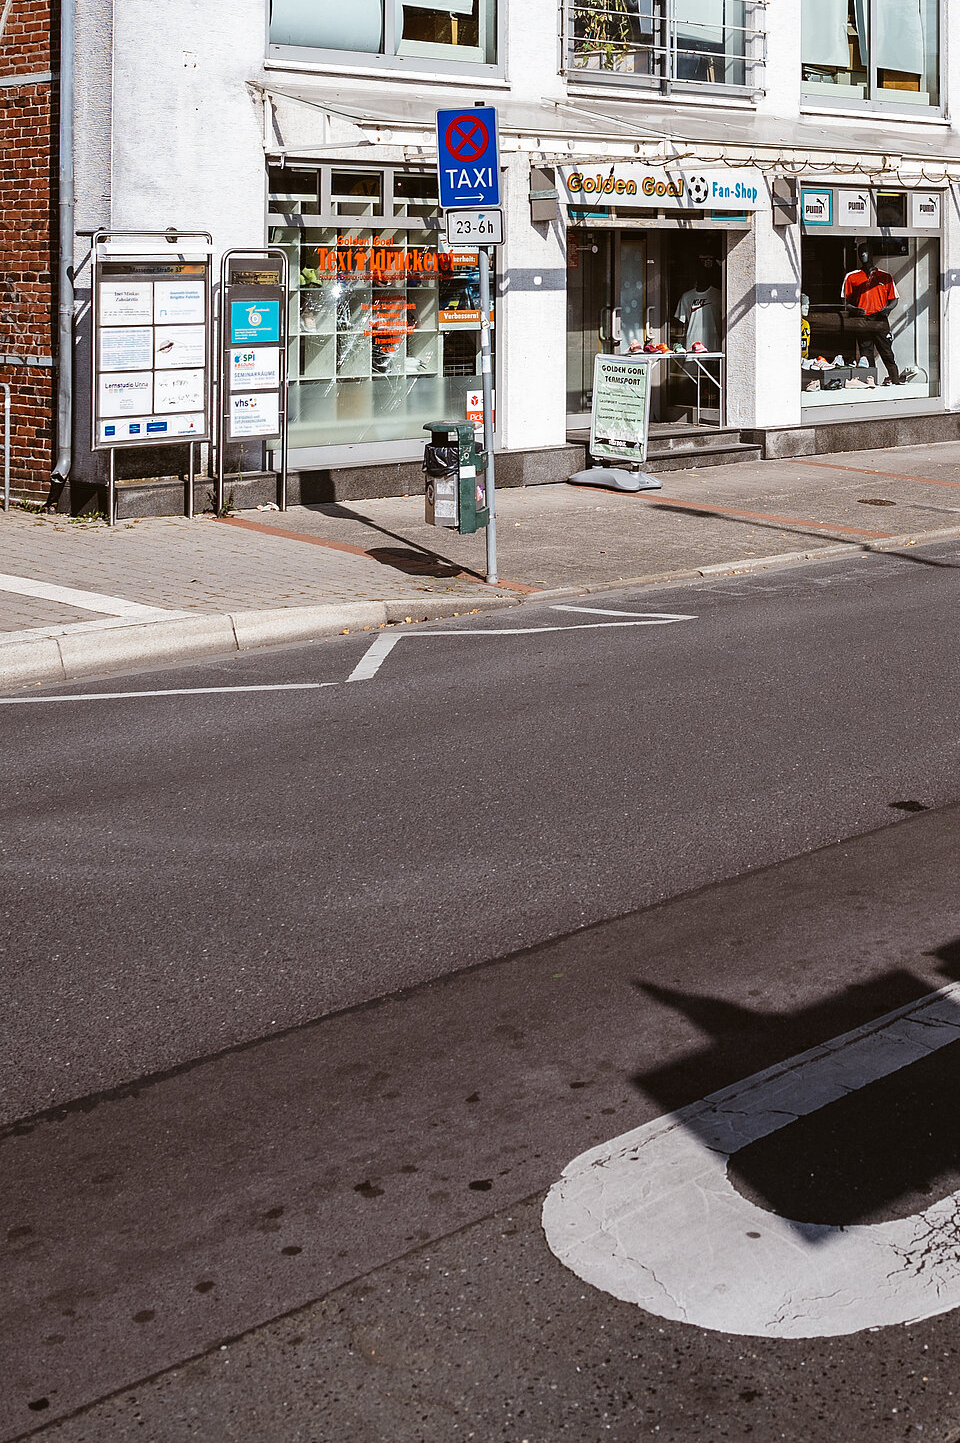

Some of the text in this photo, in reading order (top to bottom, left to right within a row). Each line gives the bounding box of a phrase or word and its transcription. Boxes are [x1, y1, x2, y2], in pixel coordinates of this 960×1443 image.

[445, 167, 493, 189] TAXI
[567, 172, 758, 204] Golden Goal Fan-Shop
[805, 205, 823, 214] PUMA
[848, 201, 865, 211] PUMA
[919, 204, 935, 213] PUMA
[456, 220, 494, 234] 23-6h
[337, 235, 394, 246] Golden Goal
[601, 364, 645, 376] GOLDEN GOAL
[604, 375, 641, 386] TEAMSPORT
[234, 398, 249, 408] vhs
